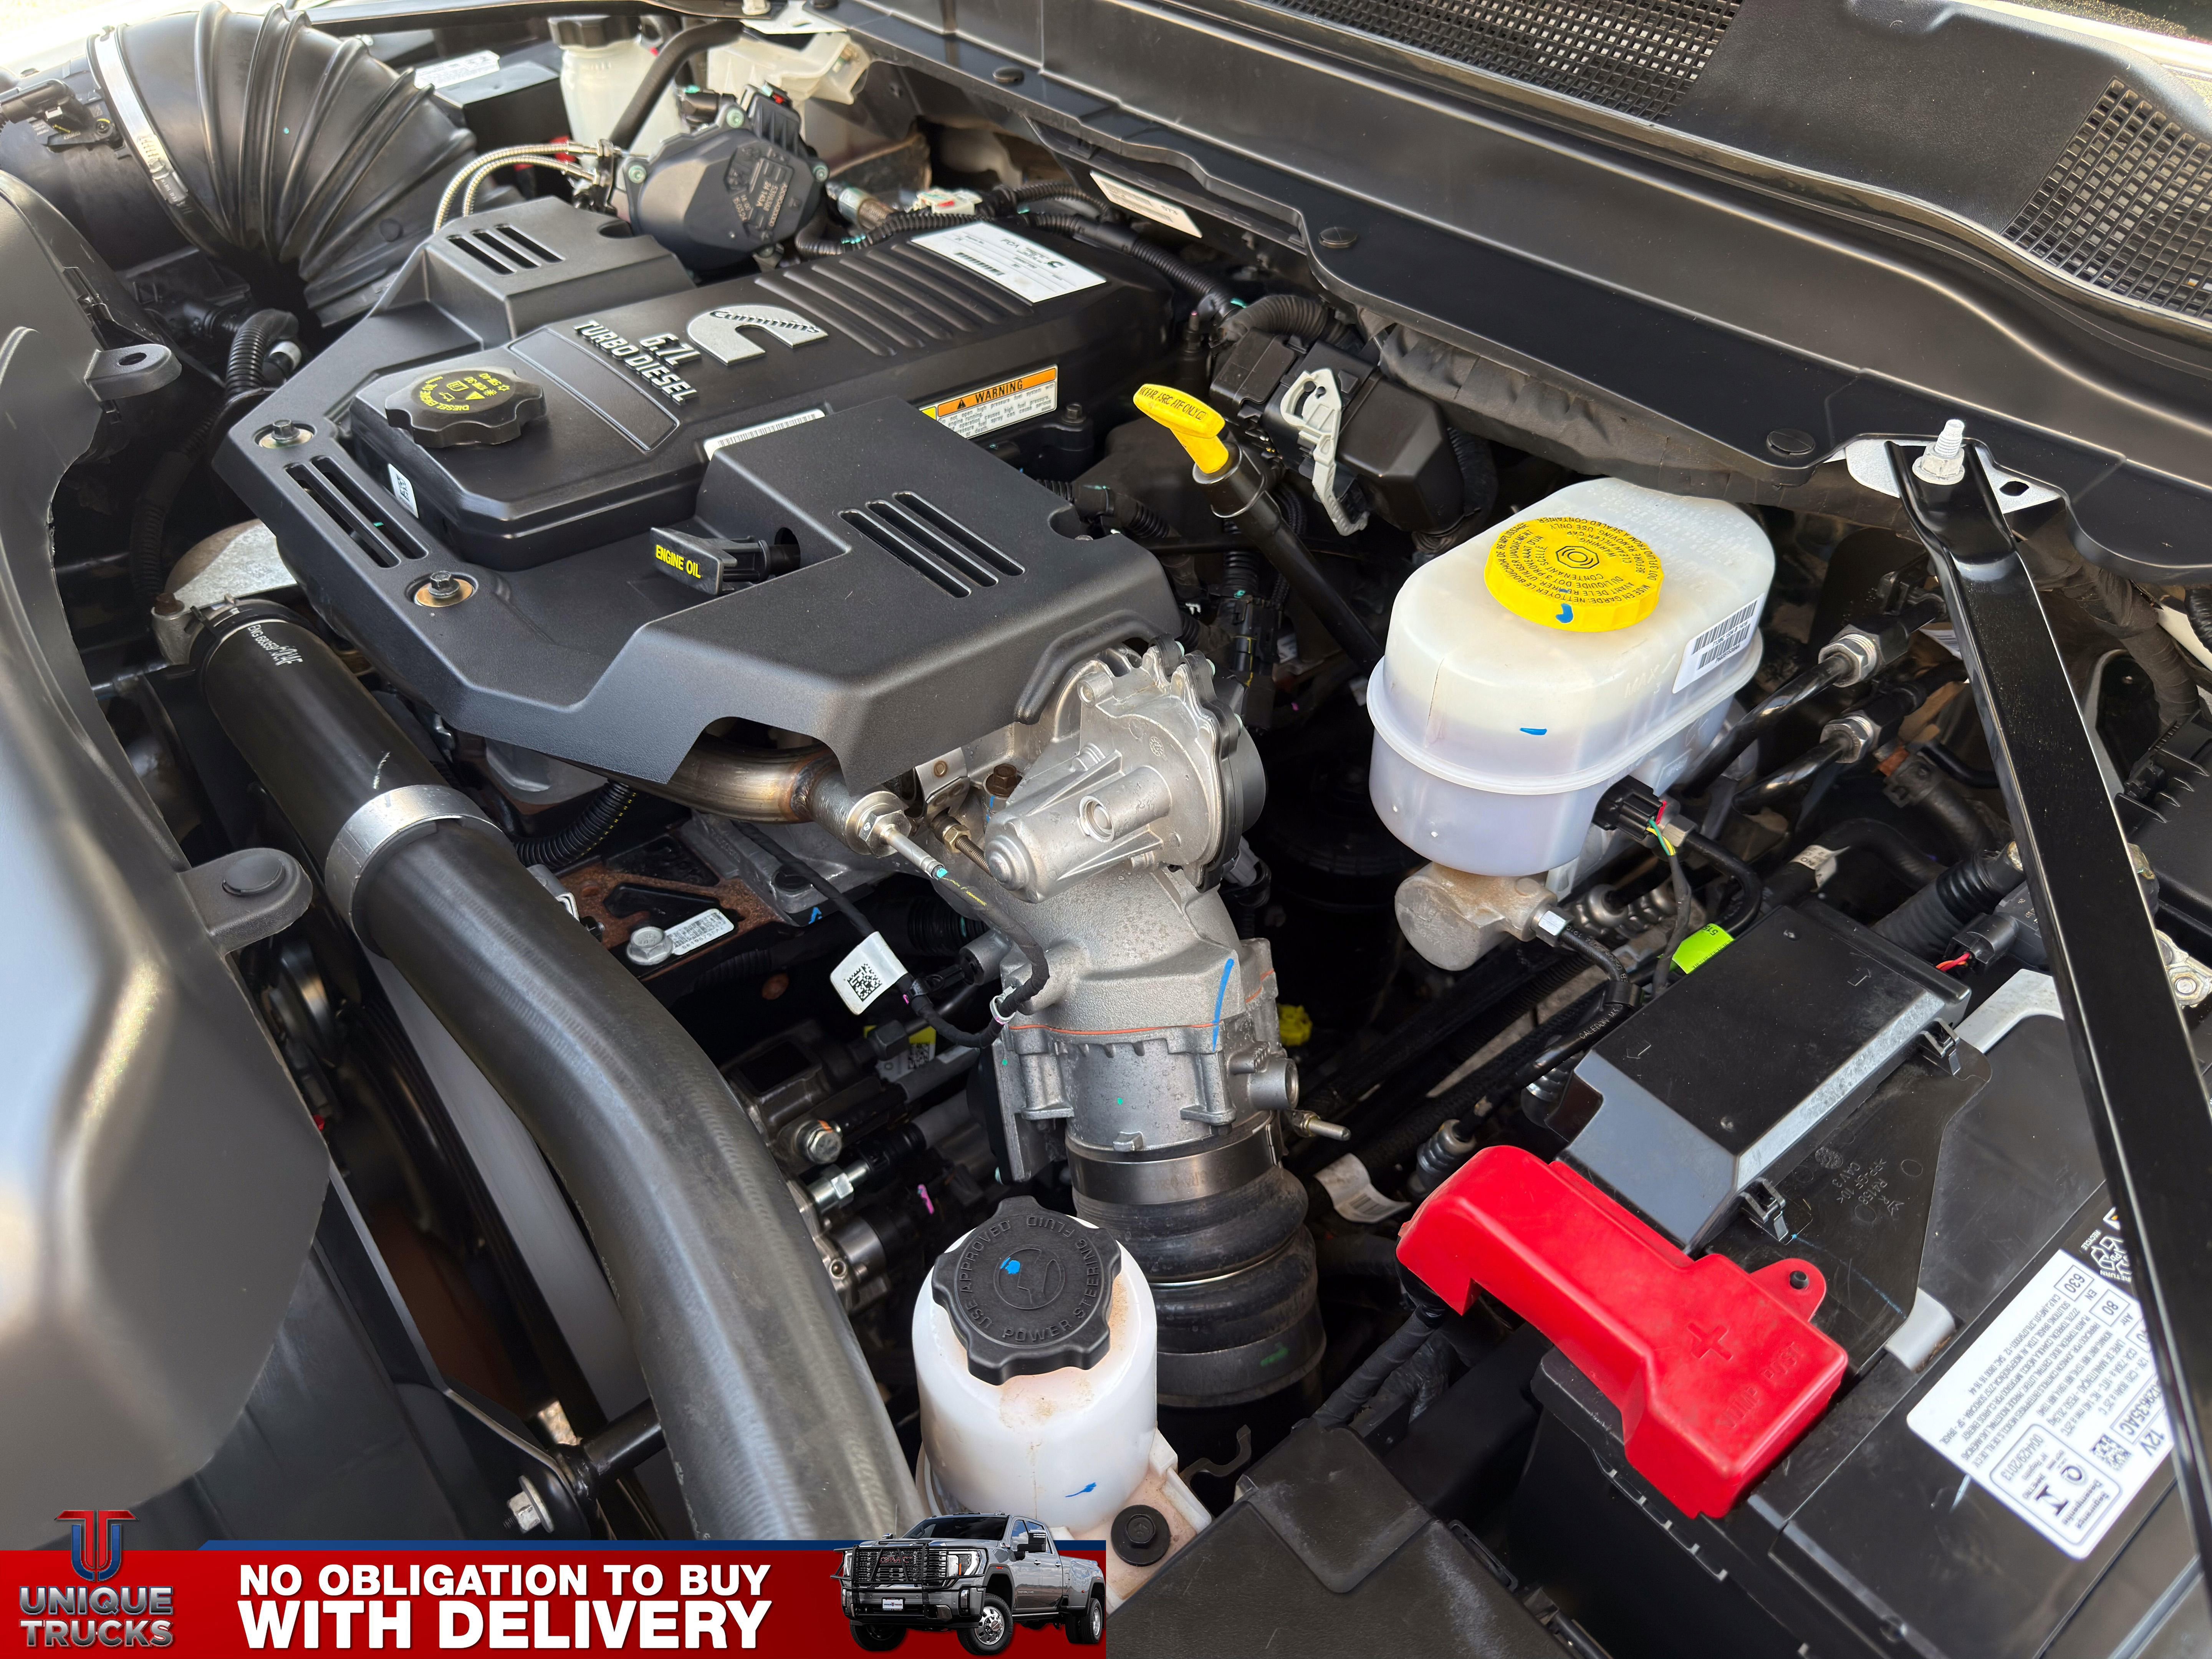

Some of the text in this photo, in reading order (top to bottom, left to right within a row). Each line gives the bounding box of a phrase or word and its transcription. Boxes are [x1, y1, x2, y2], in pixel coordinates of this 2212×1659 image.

[710, 310, 821, 334] Cummins
[639, 333, 702, 369] 6.7L
[573, 319, 698, 406] TURBO DIESEL
[420, 390, 440, 407] ENGINE
[975, 380, 1023, 403] WARNING
[437, 403, 470, 411] DIESEL
[962, 410, 973, 418] open
[991, 398, 1010, 408] pressure
[1026, 388, 1041, 397] system
[991, 416, 1003, 425] spray
[1036, 399, 1051, 408] serious
[948, 412, 983, 427] engine running.
[960, 418, 980, 429] operation
[984, 411, 1000, 420] causes
[1496, 522, 1530, 550] REMPLISSAGE
[1590, 520, 1623, 534] SEALED
[1576, 537, 1616, 558] WARNING:
[1587, 533, 1616, 546] FILLER
[1597, 528, 1637, 552] REMOVING.
[1627, 536, 1649, 551] FROM
[656, 544, 701, 579] ENGINE OIL
[1613, 546, 1632, 564] CLEAN
[1632, 553, 1646, 574] BEFORE
[1644, 551, 1658, 567] FLUID
[1497, 558, 1527, 584] BOUCHON
[1511, 560, 1538, 581] UTILISER
[1545, 566, 1604, 581] CONTENANT
[1611, 575, 1624, 585] DU
[1647, 570, 1659, 581] DOT
[1523, 581, 1536, 590] LE
[1552, 578, 1572, 587] DOT
[1576, 580, 1613, 589] LIQUIDE
[1612, 582, 1634, 594] AVANT
[1632, 584, 1651, 595] MISE
[1536, 587, 1585, 603] NETTOYER
[1588, 596, 1623, 604] GARDE:
[248, 624, 263, 637] ENG
[1577, 1015, 1610, 1041] CALEDON
[1831, 1162, 1861, 1188] CAV 3
[1857, 1178, 1887, 1205] R4158
[2080, 1229, 2101, 1251] RECYCLE
[960, 1215, 1075, 1330] USE APPROVED FLUID
[2062, 1271, 2086, 1295] 630
[2099, 1269, 2132, 1282] RETURN
[1001, 1238, 1100, 1342] POWER STEERING
[2083, 1288, 2097, 1302] EN
[2046, 1299, 2071, 1326] SOLUTIONS
[2099, 1298, 2119, 1318] 80
[2072, 1313, 2091, 1333] PLANTA
[2118, 1311, 2134, 1327] Ahr
[2077, 1320, 2101, 1346] FABRICADO
[2094, 1329, 2114, 1350] NORMAS
[2103, 1350, 2116, 1363] DE
[2108, 1338, 2126, 1356] LIVRE
[1983, 1363, 1997, 1378] 0800
[1991, 1352, 2025, 1389] INDEPENDÊNCIA
[1992, 1354, 2006, 1368] SAC:
[2053, 1350, 2075, 1373] JOHNSON
[2135, 1355, 2150, 1371] 12V
[1982, 1382, 1997, 1397] 2757
[1999, 1371, 2024, 1397] IMPORTADO
[2035, 1368, 2060, 1394] CONTROLS
[1963, 1393, 1988, 1420] SOROCABA
[2005, 1389, 2025, 1410] PARQUE
[2013, 1389, 2042, 1420] ENTERPRISES
[1975, 1401, 1997, 1424] CLARIOS
[1960, 1420, 1981, 1442] ENERGY
[2136, 1424, 2167, 1457] 12V
[1960, 1435, 1986, 1462] AMÉRICAS
[1997, 1431, 2046, 1483] 004429/2013
[2019, 1458, 2043, 1483] Registro
